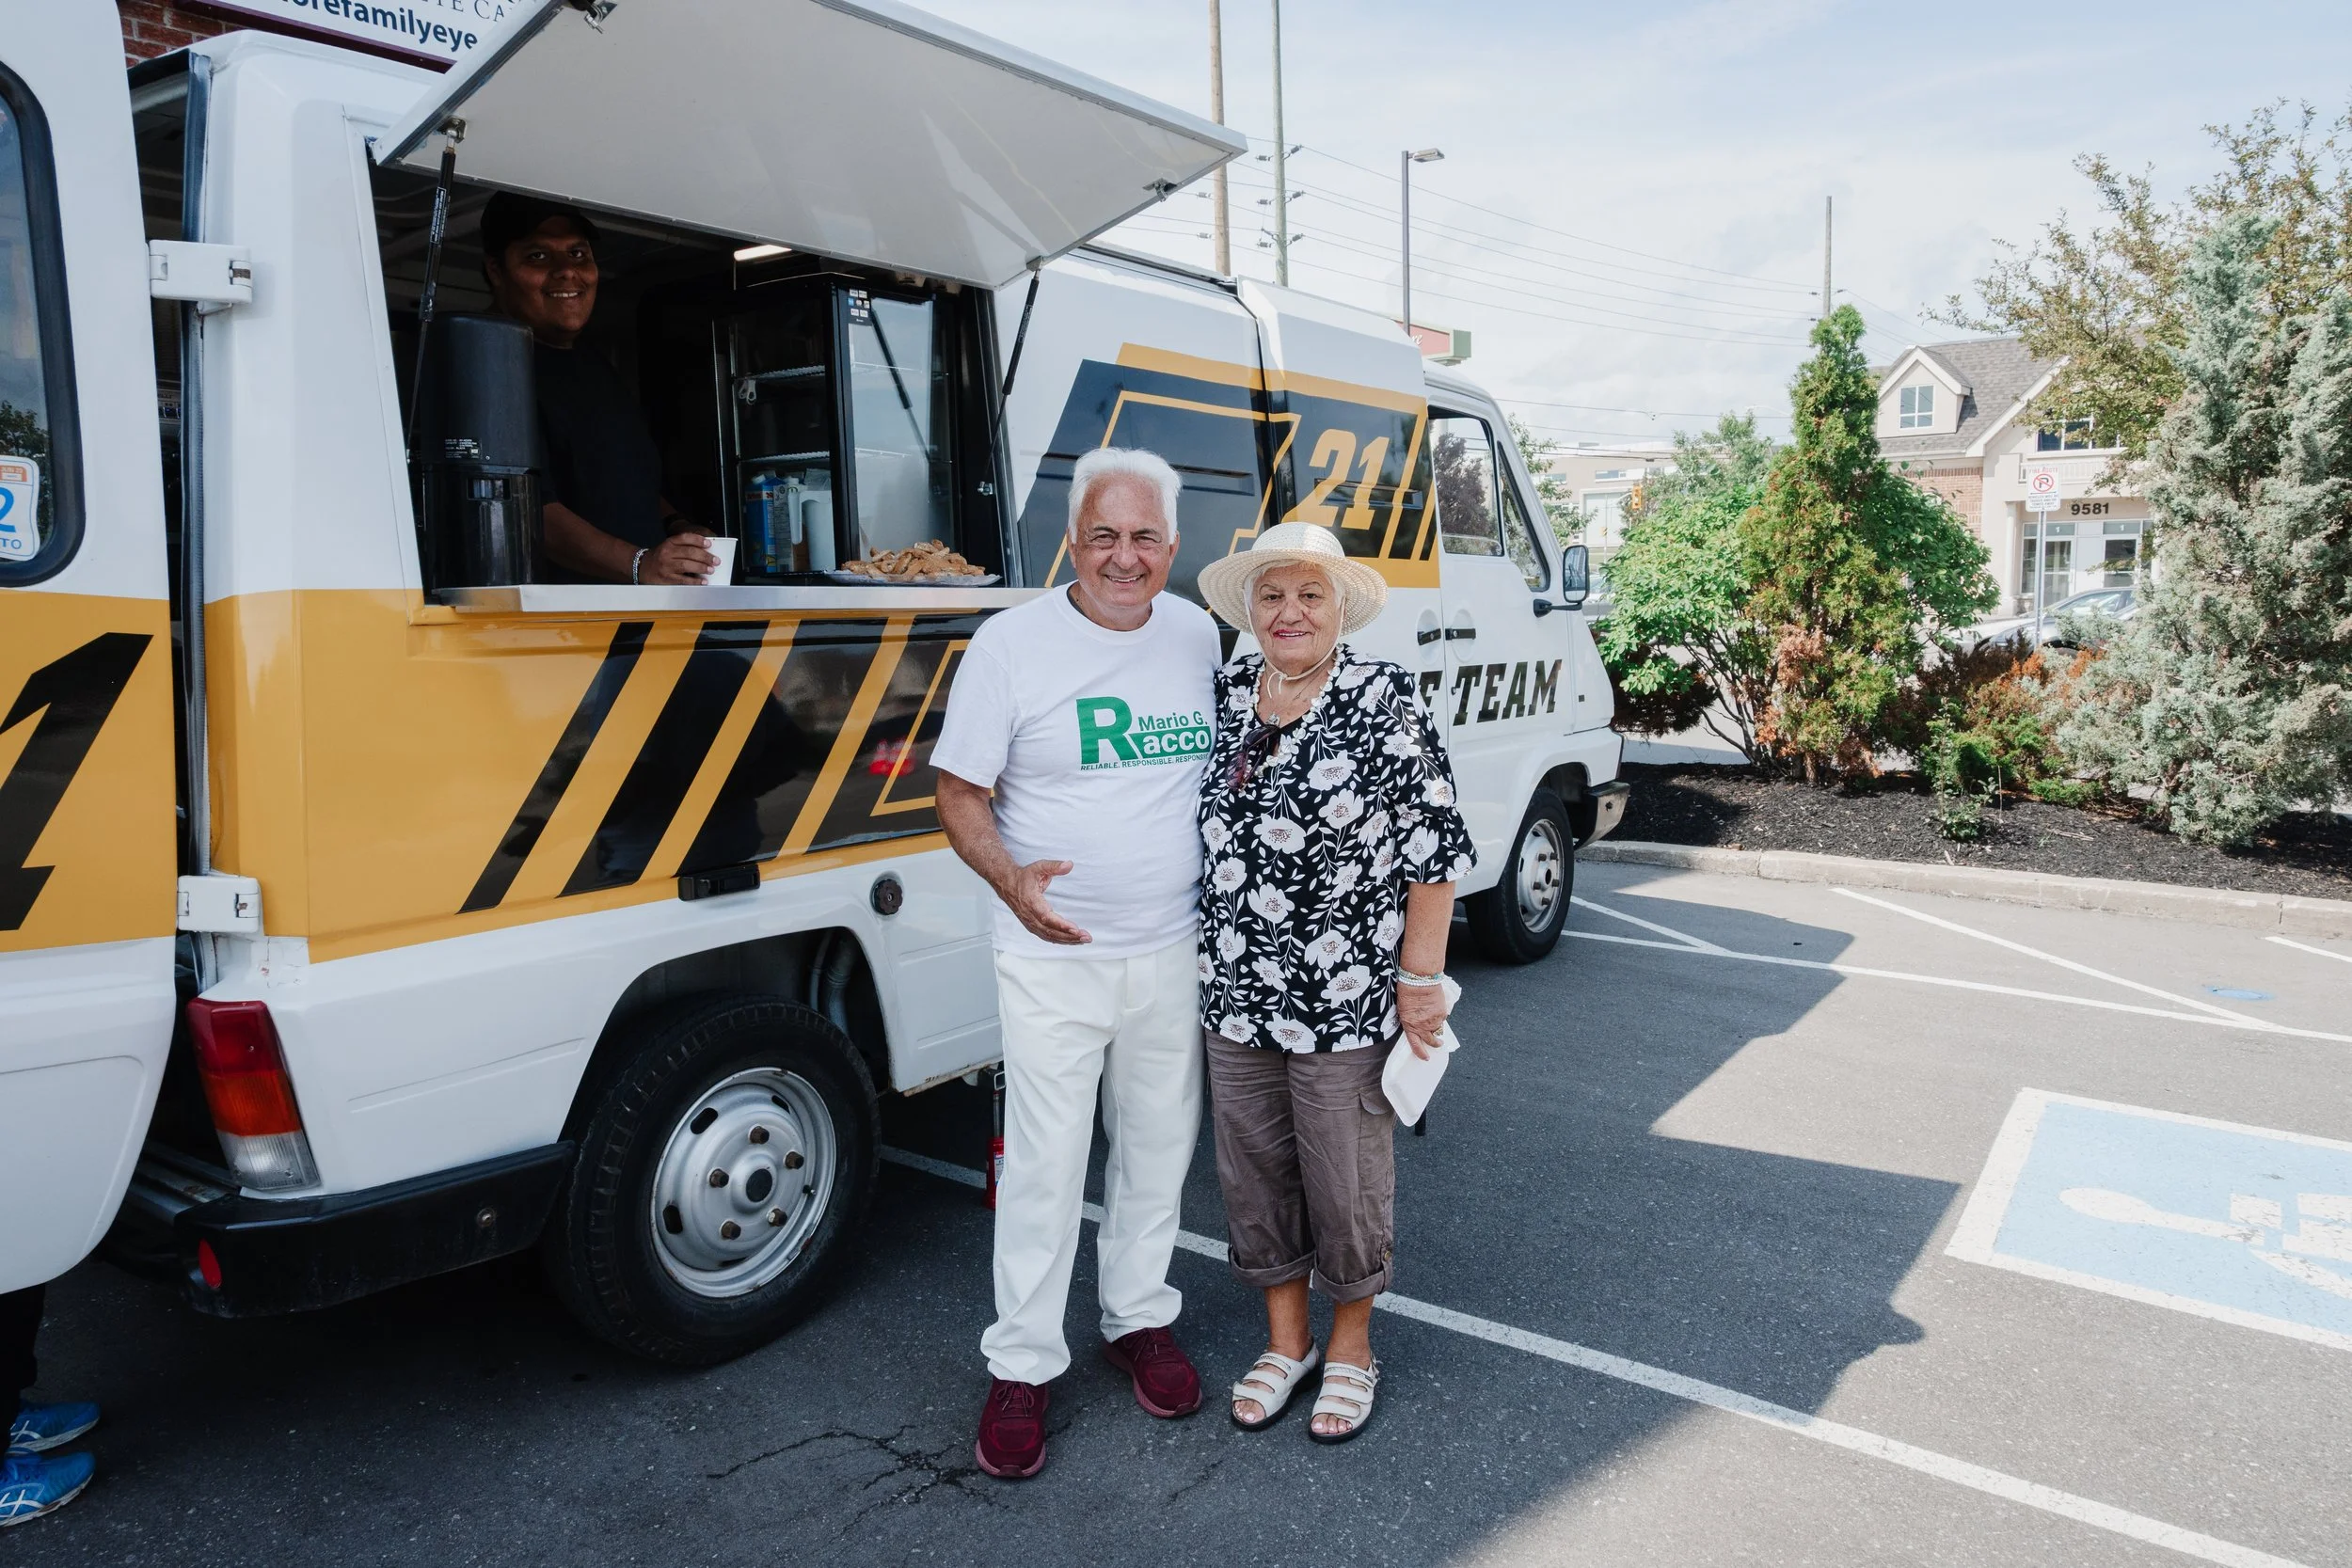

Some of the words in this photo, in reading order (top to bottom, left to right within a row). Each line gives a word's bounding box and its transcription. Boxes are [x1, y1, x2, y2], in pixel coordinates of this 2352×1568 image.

[1280, 429, 1390, 531] 21
[2071, 502, 2109, 515] 9581
[1452, 658, 1563, 727] TEAM
[1137, 712, 1189, 732] Mario
[1193, 710, 1208, 725] G.
[1080, 761, 1120, 771] RELIABLE.
[1121, 756, 1175, 768] RESPONSIBLE.
